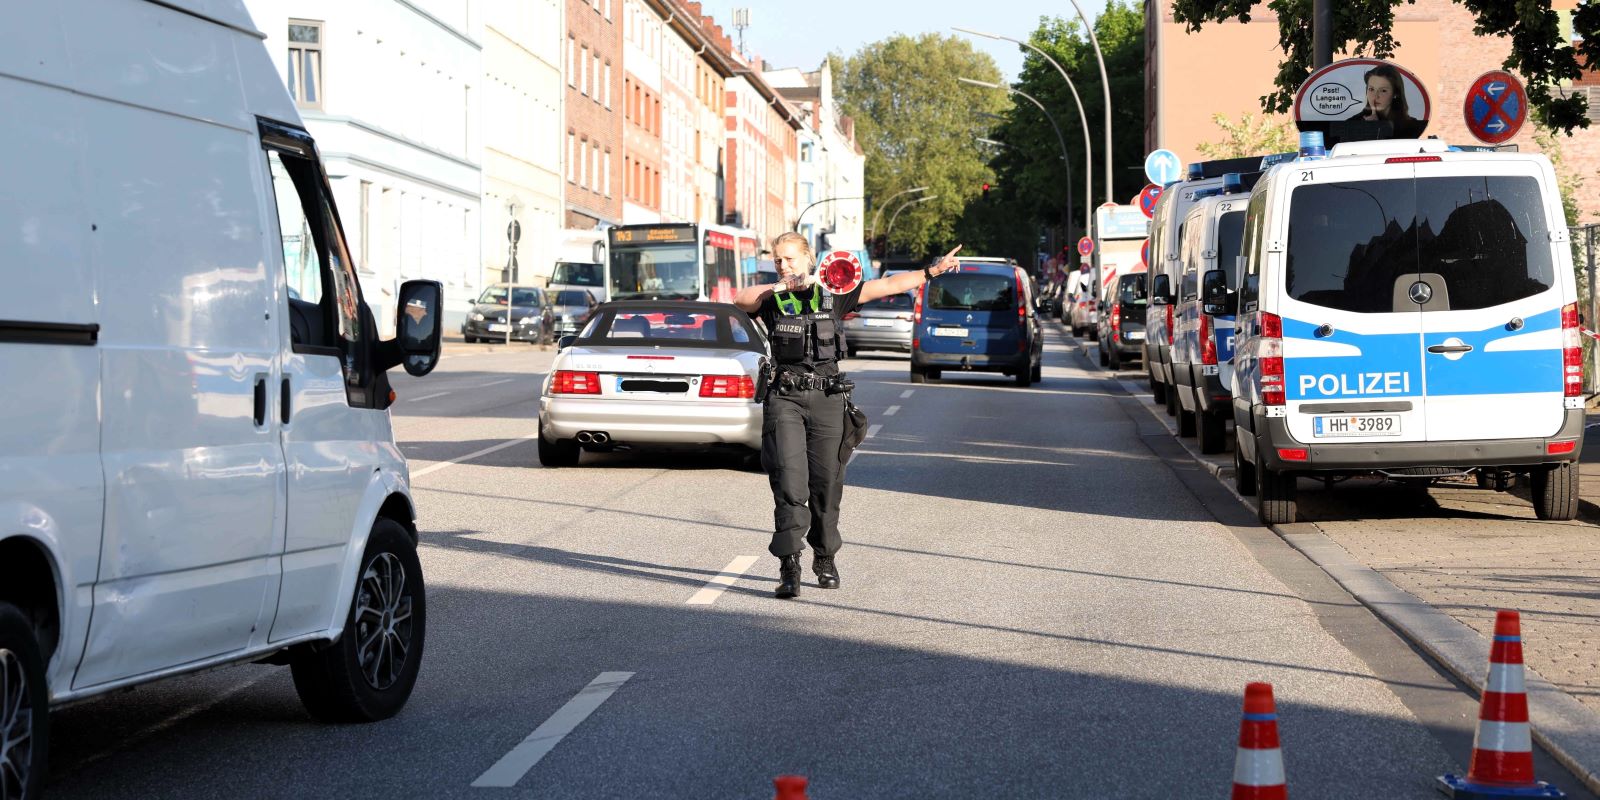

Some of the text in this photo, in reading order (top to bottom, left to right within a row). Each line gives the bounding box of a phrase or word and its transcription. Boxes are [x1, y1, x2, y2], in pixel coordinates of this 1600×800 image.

[1315, 94, 1347, 102] Langsam
[1301, 170, 1314, 181] 21
[1221, 203, 1232, 211] 22
[775, 324, 802, 333] POLIZEI
[1299, 371, 1410, 396] POLIZEI
[1330, 417, 1393, 432] HH 3989
